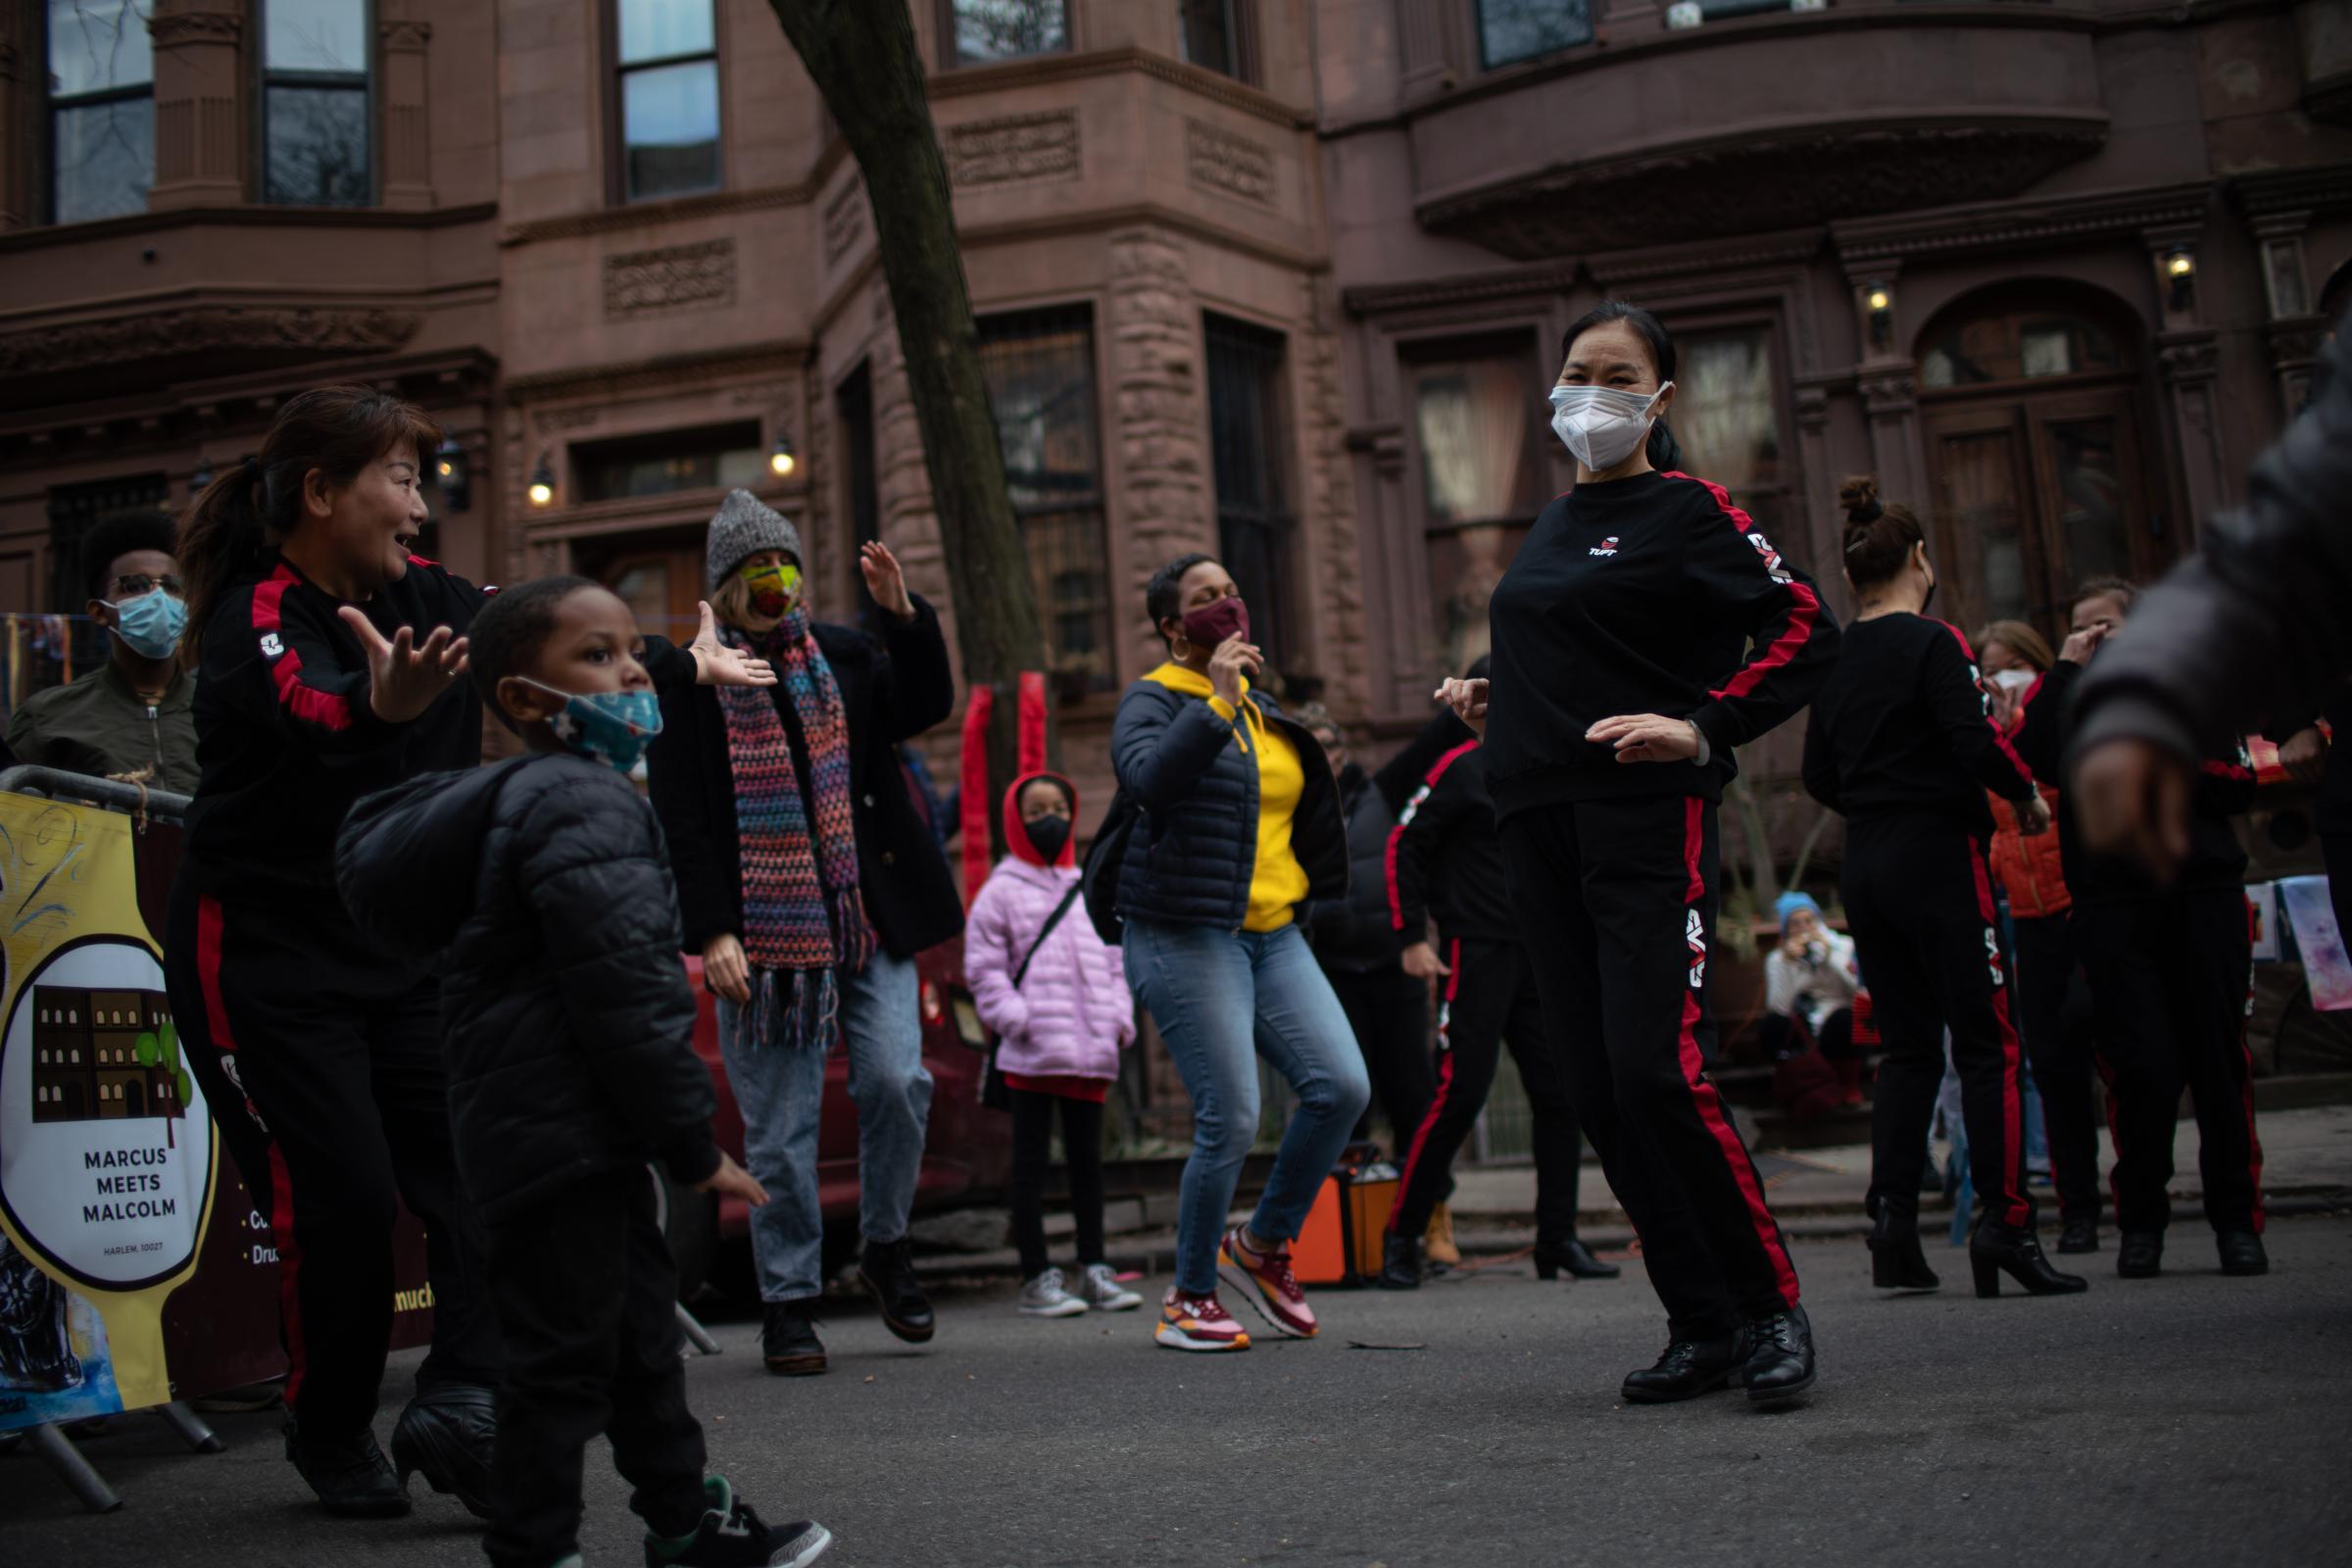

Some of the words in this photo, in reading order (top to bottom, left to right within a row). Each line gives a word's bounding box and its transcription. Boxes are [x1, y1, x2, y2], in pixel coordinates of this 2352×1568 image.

[84, 1148, 167, 1169] MARCUS
[96, 1174, 161, 1195] MEETS
[82, 1199, 176, 1223] MALCOLM
[104, 1245, 139, 1255] HARLEM,
[253, 1244, 280, 1265] Dru
